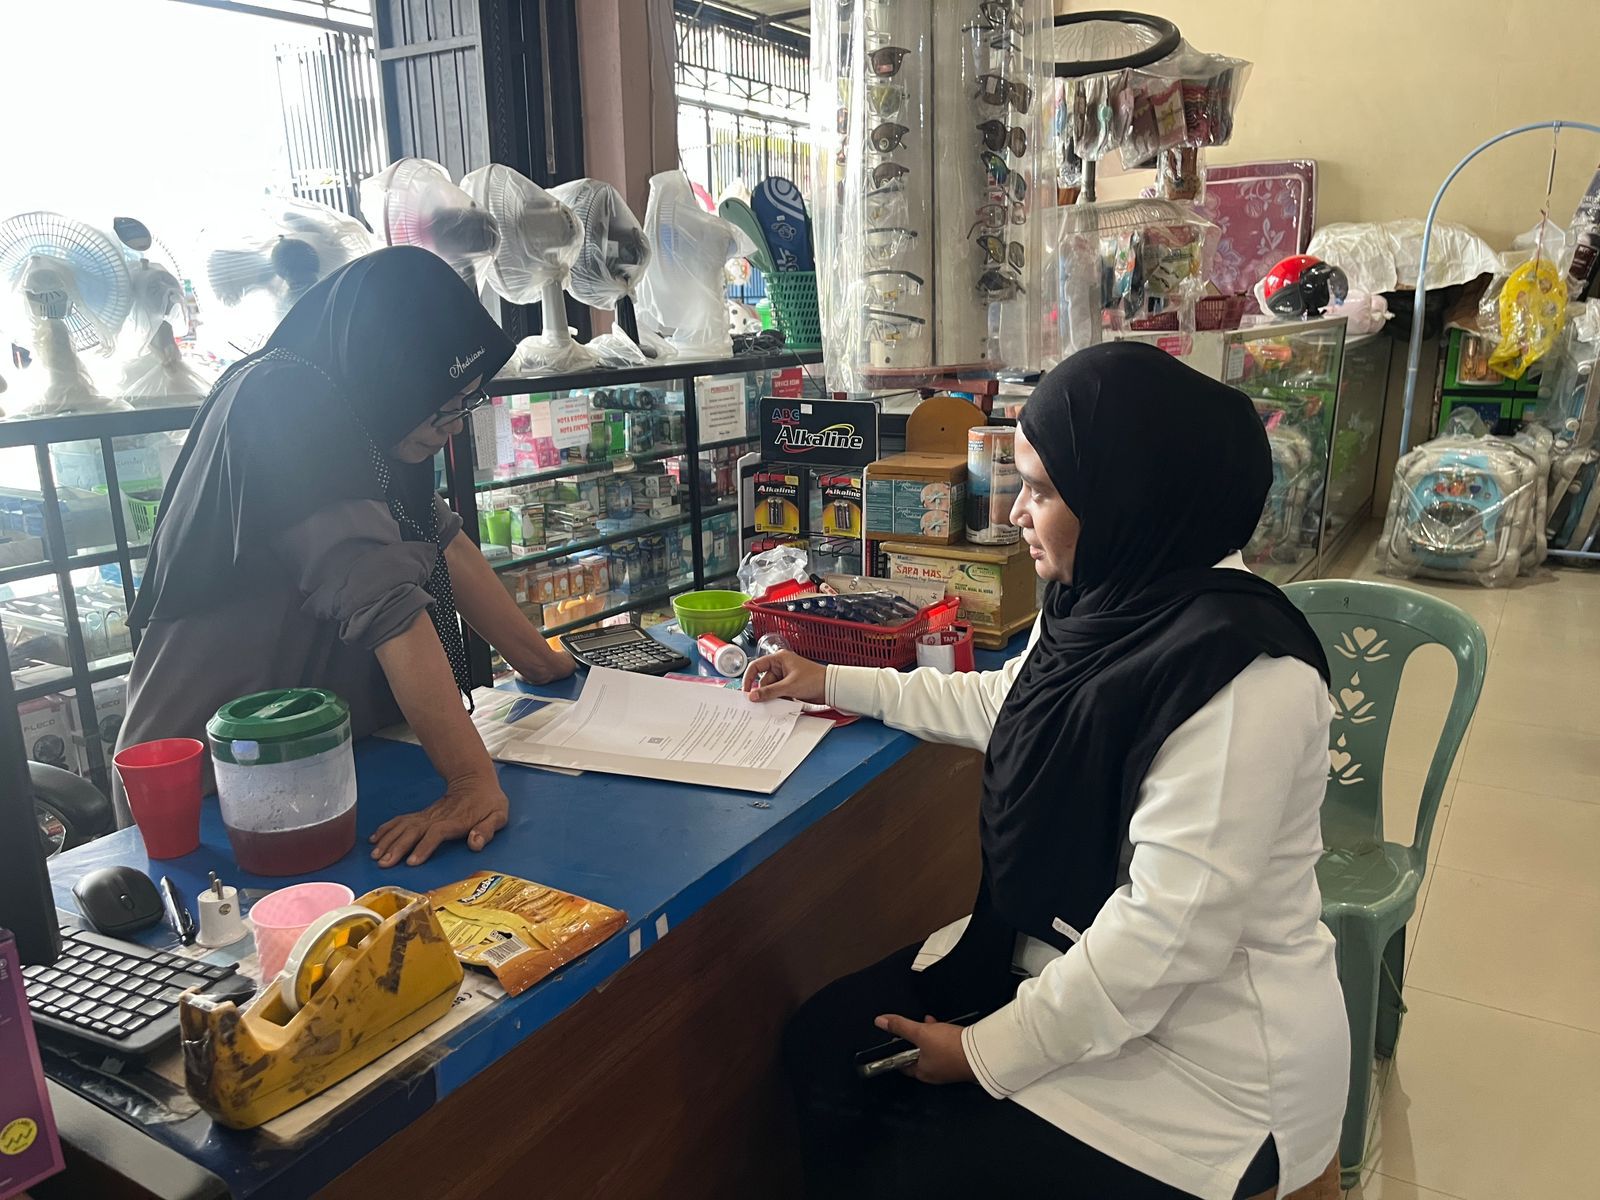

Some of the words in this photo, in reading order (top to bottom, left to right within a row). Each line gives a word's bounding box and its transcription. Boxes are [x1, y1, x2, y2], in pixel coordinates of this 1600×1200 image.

[772, 408, 800, 421] ABC
[774, 425, 864, 449] Alkaline
[757, 485, 796, 495] Alkaline
[825, 487, 861, 498] Alkaline
[896, 565, 919, 576] SAPA
[922, 568, 942, 579] MAS
